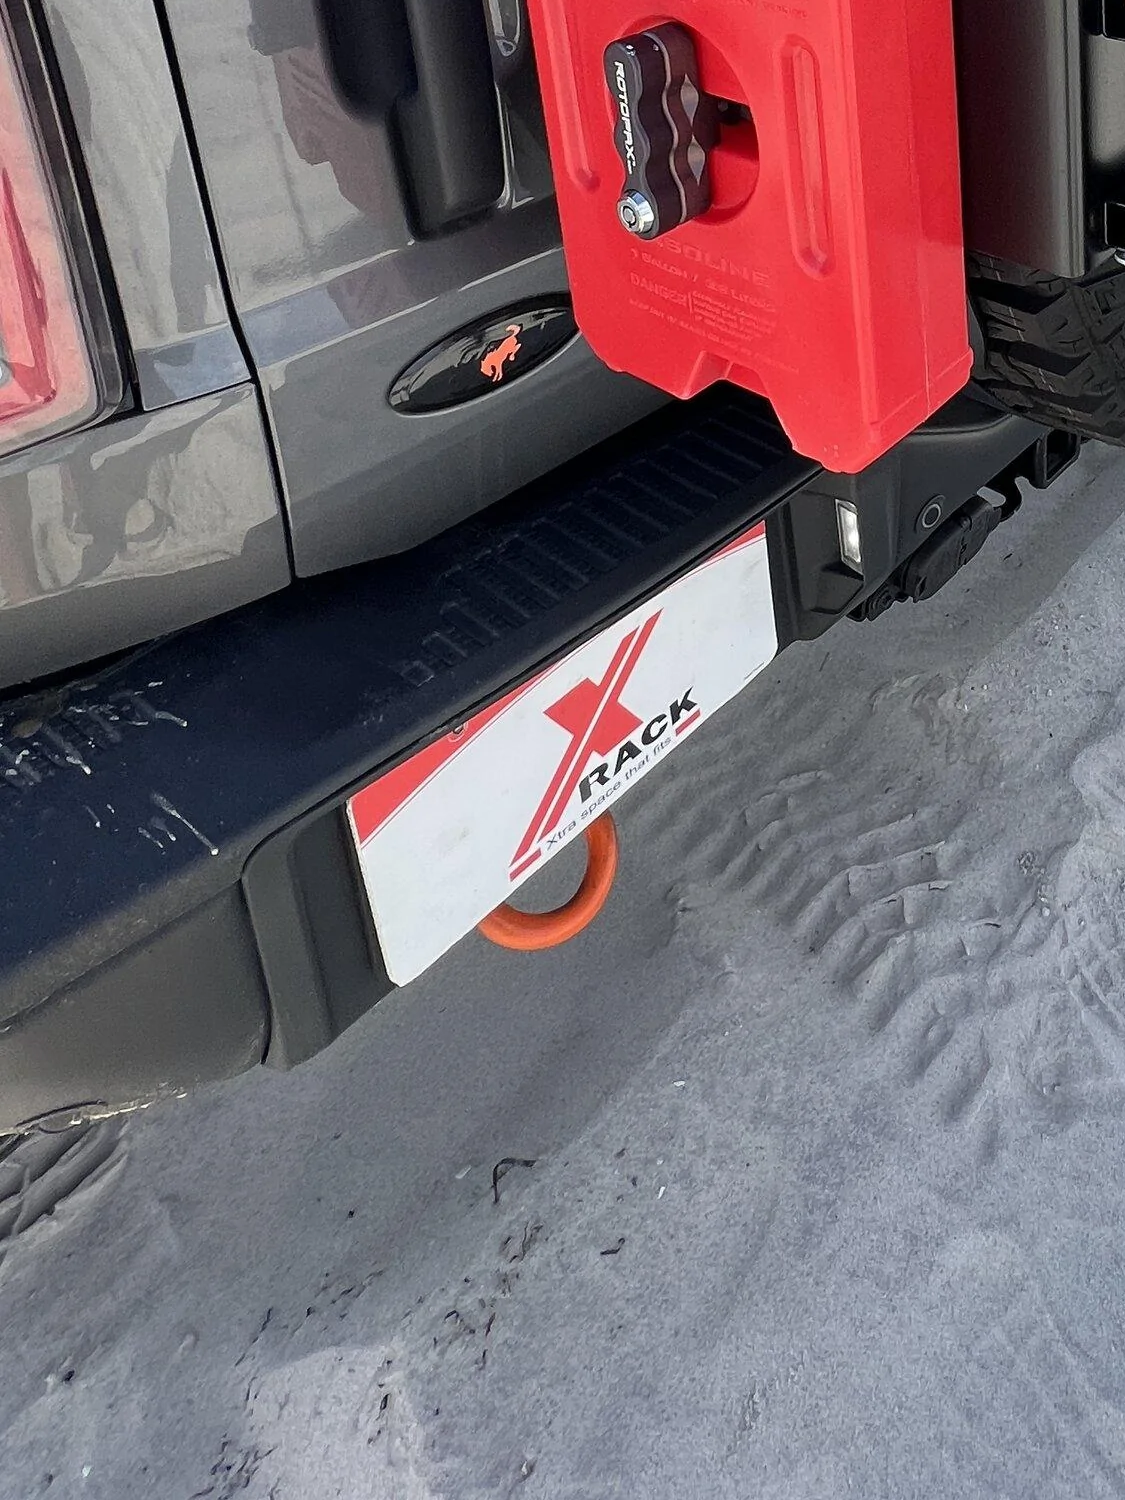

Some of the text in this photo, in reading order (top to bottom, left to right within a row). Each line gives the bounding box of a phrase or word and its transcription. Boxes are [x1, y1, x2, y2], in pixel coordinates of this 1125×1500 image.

[614, 61, 636, 163] ROTOPAX
[630, 271, 688, 307] DANGER
[656, 236, 771, 289] SOLINE
[546, 737, 671, 850] Xtra space that fits
[579, 685, 698, 804] RACK
